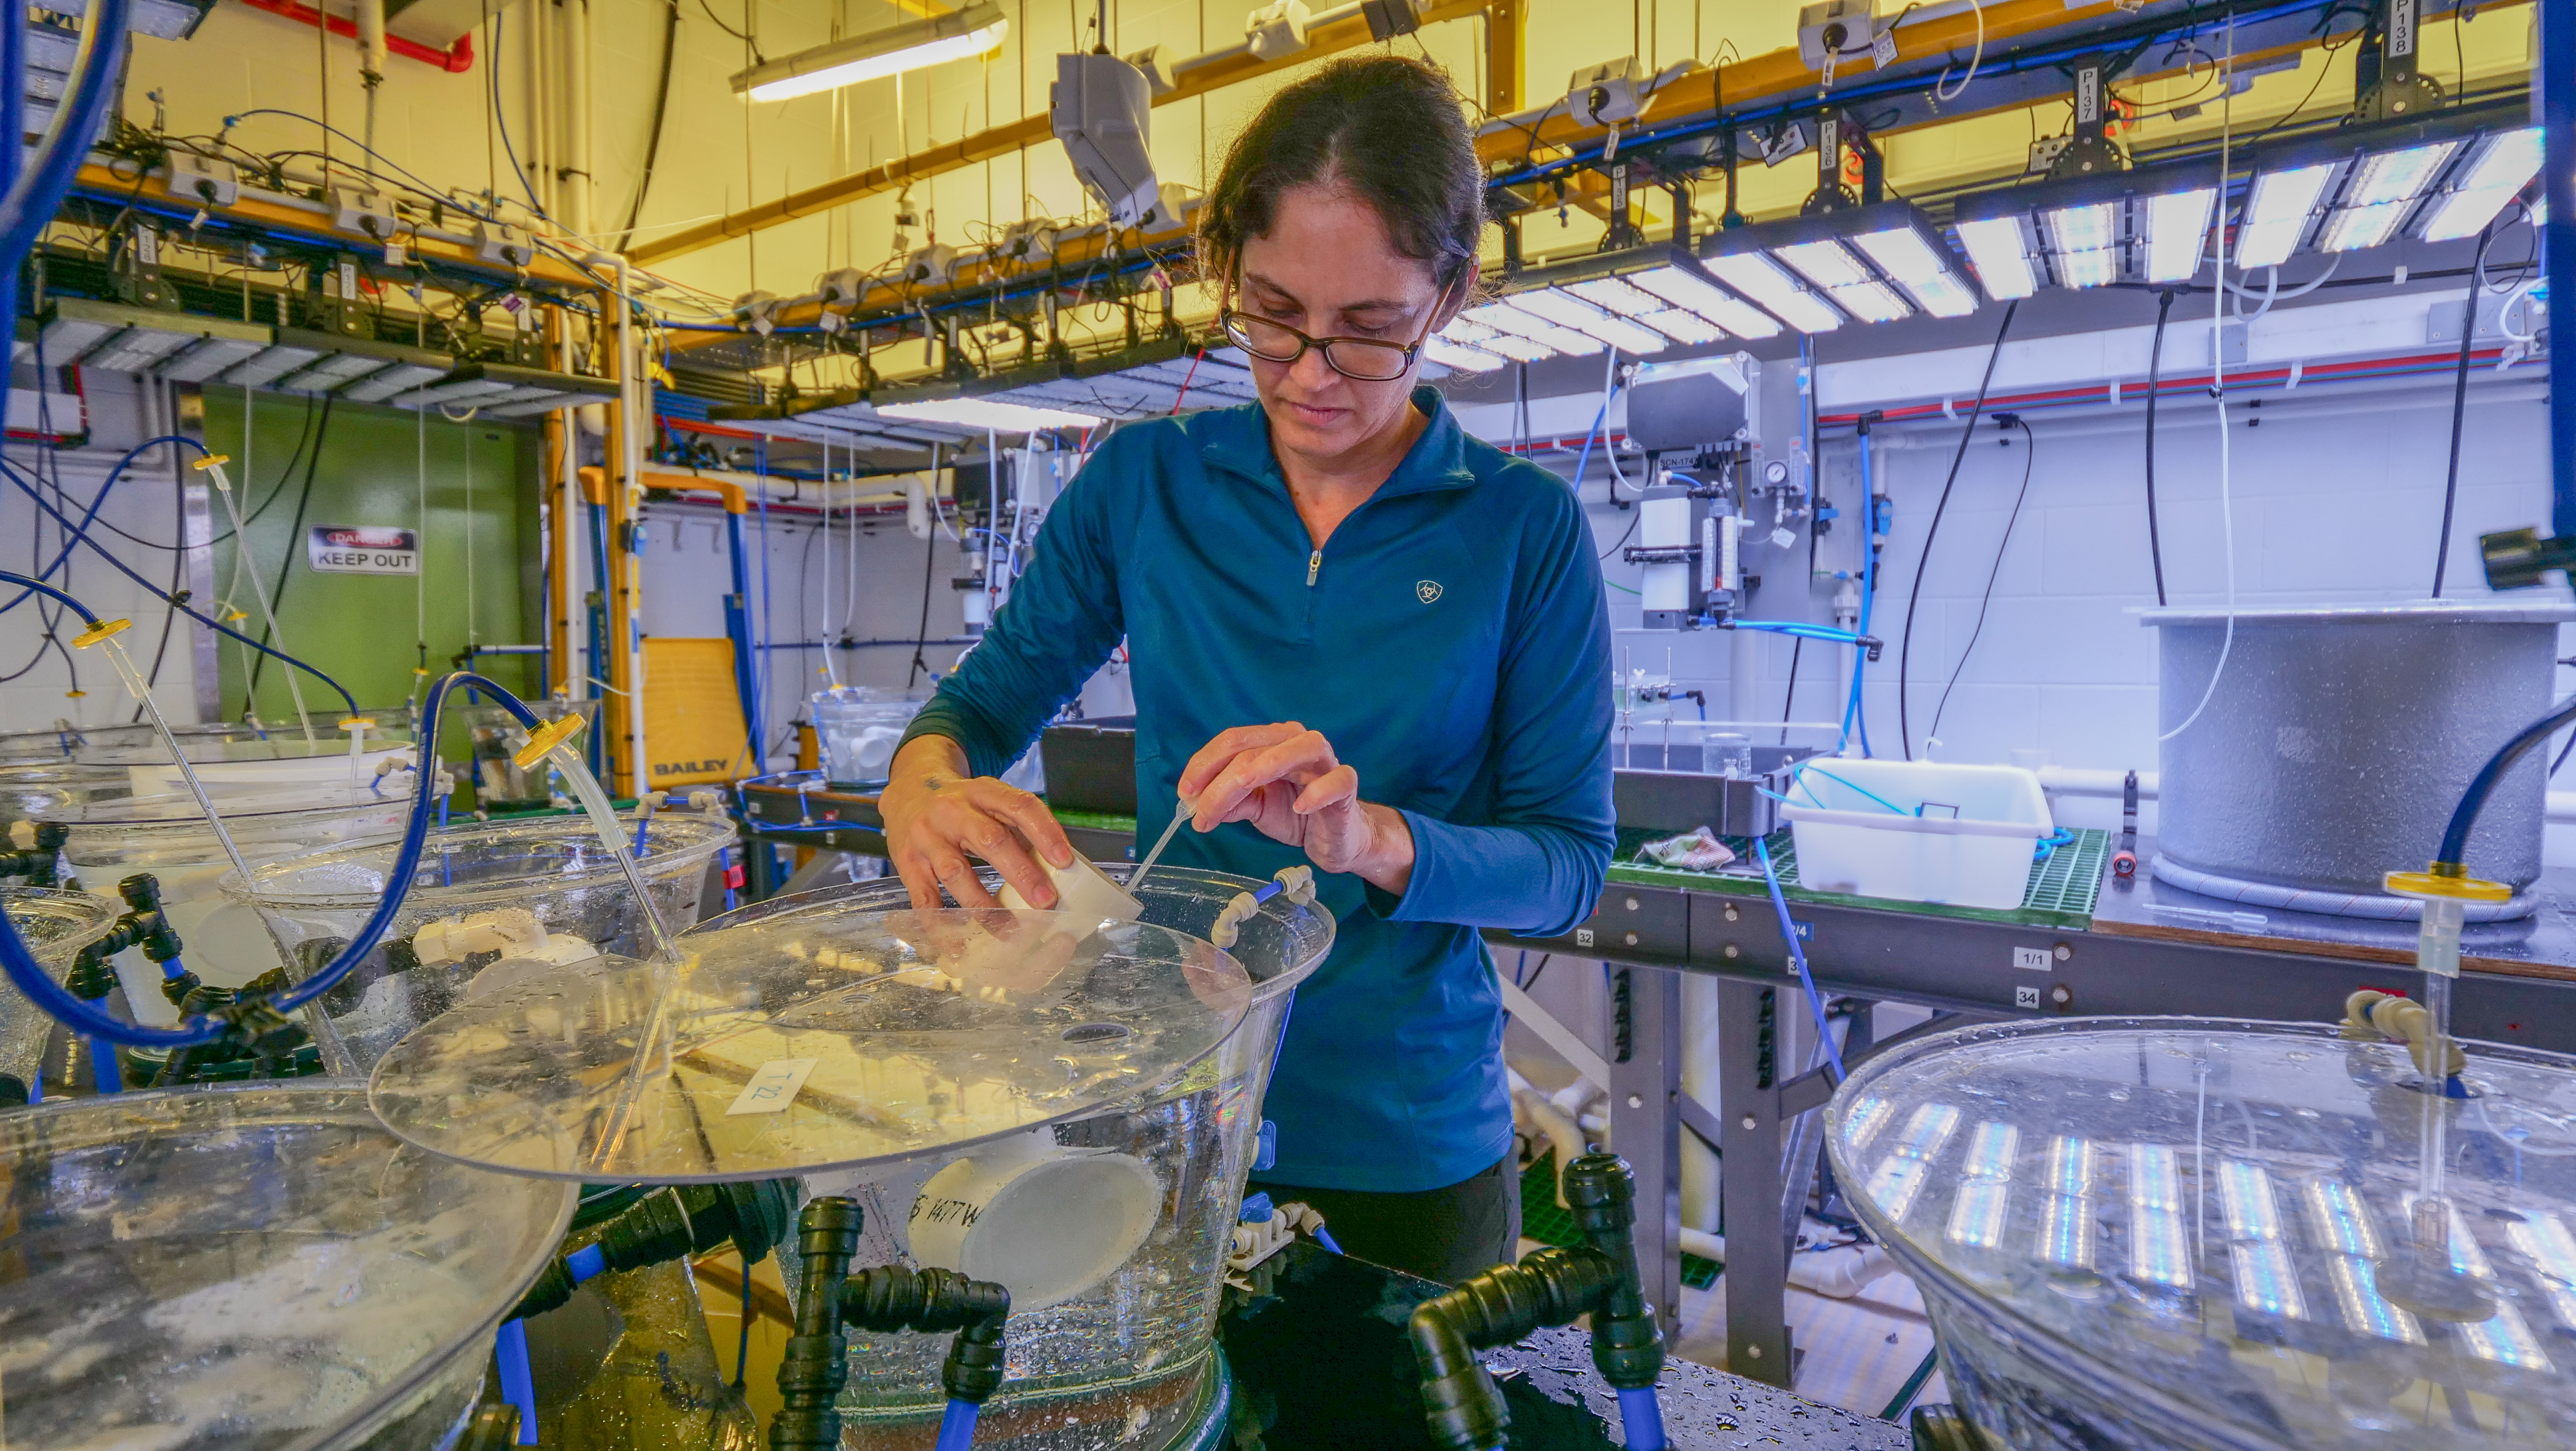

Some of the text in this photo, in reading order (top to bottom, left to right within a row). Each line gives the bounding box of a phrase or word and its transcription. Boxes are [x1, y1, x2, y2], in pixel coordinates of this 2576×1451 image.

[2396, 0, 2409, 53] P138
[2084, 71, 2093, 119] P137
[335, 532, 395, 545] DAN
[318, 552, 411, 567] KEEP OUT
[654, 759, 728, 776] BAILEY
[1579, 933, 1592, 943] 32
[2024, 953, 2042, 965] 1/1
[1790, 961, 1798, 971] 3
[2019, 991, 2036, 1004] 34
